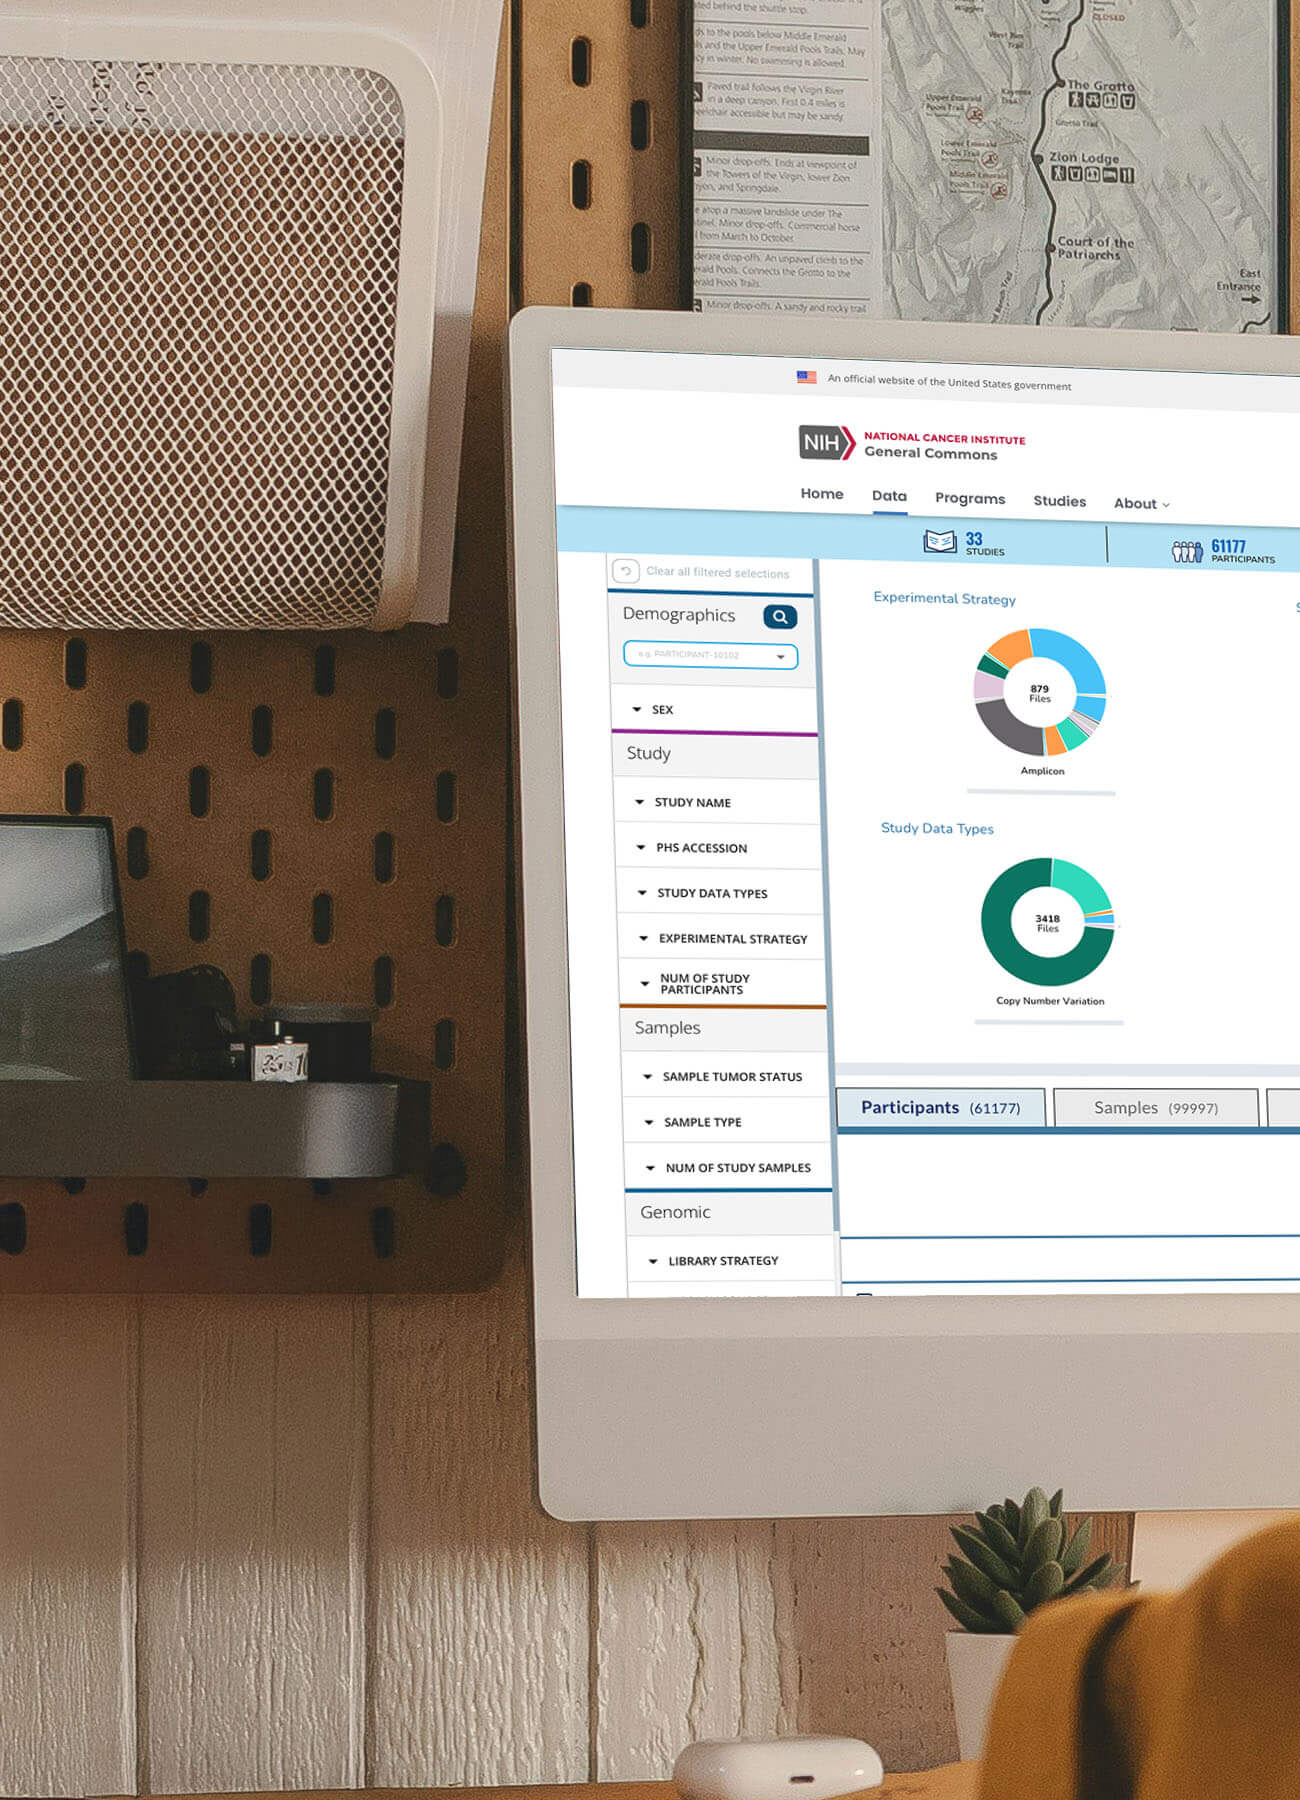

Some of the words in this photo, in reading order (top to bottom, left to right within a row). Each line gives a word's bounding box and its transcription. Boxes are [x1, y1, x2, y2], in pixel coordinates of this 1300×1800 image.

[1068, 80, 1089, 90] The
[1094, 81, 1135, 92] Grotto
[1051, 152, 1077, 163] Zion
[1082, 153, 1119, 164] Lodge
[764, 208, 800, 217] landslide
[1058, 236, 1092, 247] Court
[1098, 236, 1111, 248] of
[1115, 238, 1134, 248] the
[1058, 250, 1120, 260] Patriarchs
[1240, 269, 1261, 278] East
[1217, 282, 1261, 292] Entrance
[828, 374, 841, 382] An
[844, 375, 875, 384] official
[878, 376, 915, 385] website
[917, 377, 928, 385] of
[930, 378, 946, 386] the
[948, 379, 980, 387] United
[983, 380, 1012, 389] States
[1014, 383, 1071, 391] government
[805, 434, 839, 451] NIH
[865, 432, 920, 441] NATIONAL
[923, 434, 968, 443] CANCER
[971, 436, 1025, 445] INSTITUTE
[865, 446, 920, 458] General
[925, 448, 997, 460] Commons
[801, 488, 844, 499] Home
[873, 490, 907, 501] Data
[936, 492, 1005, 507] Programs
[1034, 496, 1086, 507] Studies
[1115, 498, 1157, 509] About
[966, 532, 982, 546] 33
[1212, 539, 1246, 553] 61177
[966, 548, 1005, 556] STUDIES
[1212, 555, 1275, 564] PARTICIPANTS
[647, 566, 674, 576] Clear
[678, 567, 690, 576] all
[694, 567, 731, 577] filtered
[734, 569, 790, 579] selections
[874, 591, 958, 604] Experimental
[962, 593, 1016, 608] Strategy
[624, 607, 735, 624] Demographics
[1031, 685, 1049, 693] 879
[1030, 694, 1051, 703] Files
[653, 705, 673, 714] SEX
[627, 746, 671, 764] Study
[1021, 767, 1065, 776] Amplicon
[656, 798, 693, 807] STUDY
[697, 798, 731, 808] NAME
[881, 822, 919, 835] Study
[923, 823, 952, 834] Data
[956, 823, 994, 836] Types
[657, 843, 679, 852] PHS
[682, 843, 747, 853] ACCESSION
[658, 888, 696, 898] STUDY
[699, 889, 730, 898] DATA
[733, 889, 768, 899] TYPES
[1036, 915, 1060, 923] 3418
[1037, 924, 1059, 932] Files
[660, 934, 746, 944] EXPERIMENTAL
[750, 935, 807, 944] STRATEGY
[661, 974, 689, 983] NUM
[693, 974, 708, 983] OF
[712, 974, 750, 983] STUDY
[661, 985, 743, 994] PARTICIPANTS
[996, 997, 1021, 1006] Copy
[1023, 997, 1060, 1005] Number
[1063, 997, 1104, 1005] Variation
[635, 1021, 701, 1038] Samples
[664, 1072, 709, 1081] SAMPLE
[712, 1072, 756, 1081] TUMOR
[760, 1072, 802, 1081] STATUS
[862, 1100, 959, 1116] Participants
[970, 1103, 1020, 1115] (61177)
[1095, 1101, 1158, 1116] Samples
[1169, 1103, 1218, 1116] (99997)
[665, 1117, 710, 1127] SAMPLE
[714, 1118, 741, 1127] TYPE
[667, 1163, 695, 1173] NUM
[699, 1163, 714, 1172] OF
[717, 1163, 755, 1173] STUDY
[759, 1163, 811, 1173] SAMPLES
[641, 1206, 710, 1219] Genomic
[669, 1257, 717, 1266] LIBRARY
[720, 1256, 778, 1266] STRATEGY
